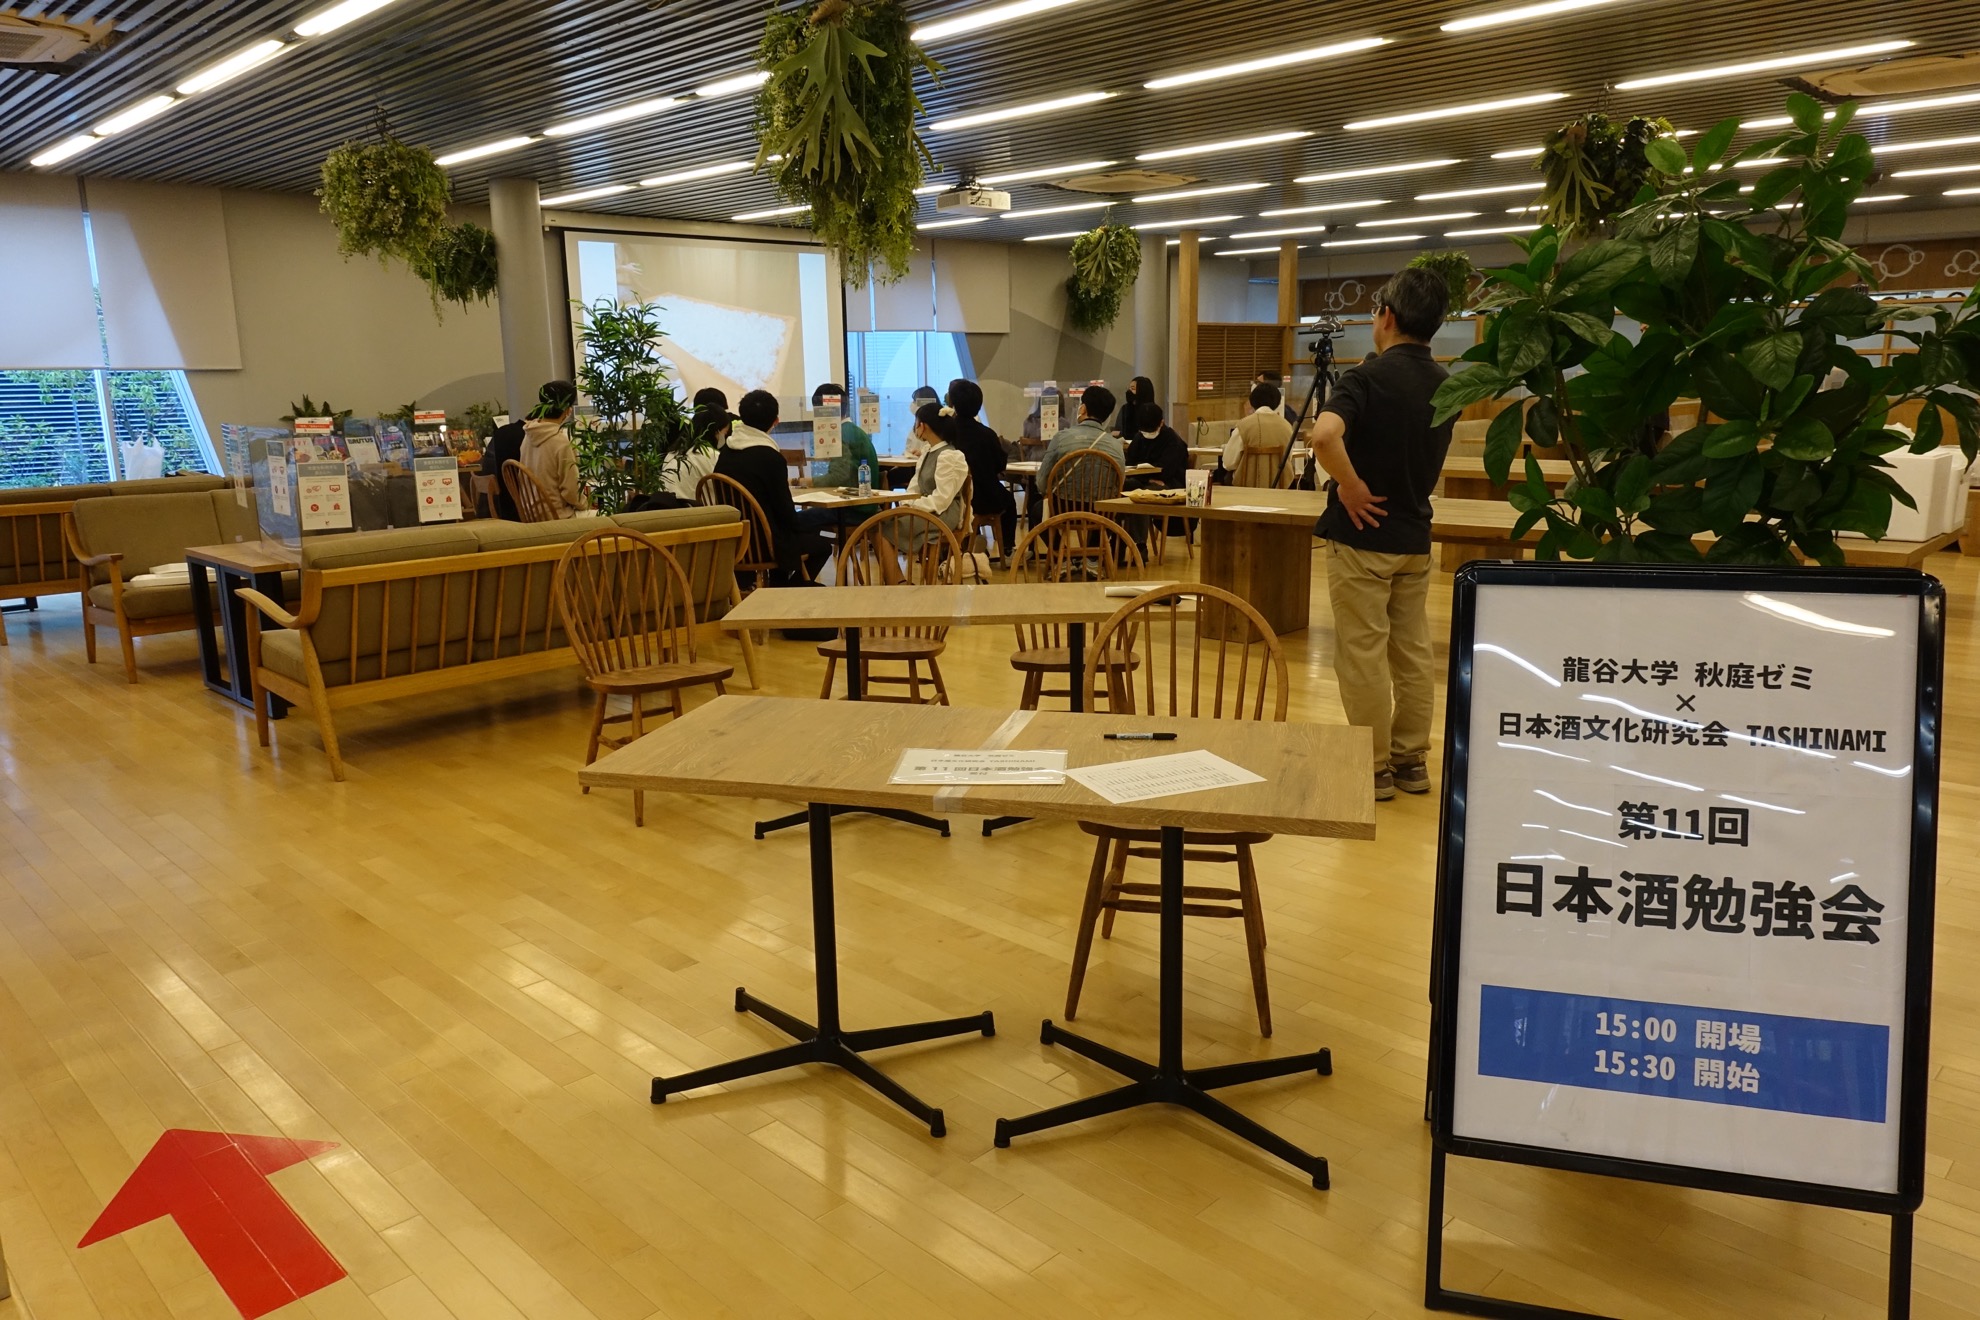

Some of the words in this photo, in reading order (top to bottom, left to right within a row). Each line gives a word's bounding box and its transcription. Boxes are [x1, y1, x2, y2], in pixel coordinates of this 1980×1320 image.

[1562, 656, 1679, 687] 龍谷大学
[1694, 661, 1813, 691] 秋庭ゼミ
[1498, 712, 1730, 748] 日本酒文化研究会
[1745, 724, 1887, 753] TASHINAMI
[1616, 800, 1750, 848] 第11回
[1495, 862, 1886, 945] 日本酒勉強会
[1595, 1011, 1678, 1043] 15:00
[1695, 1019, 1762, 1055] 開場
[1593, 1049, 1677, 1081] 15:30
[1693, 1057, 1761, 1094] 開始
